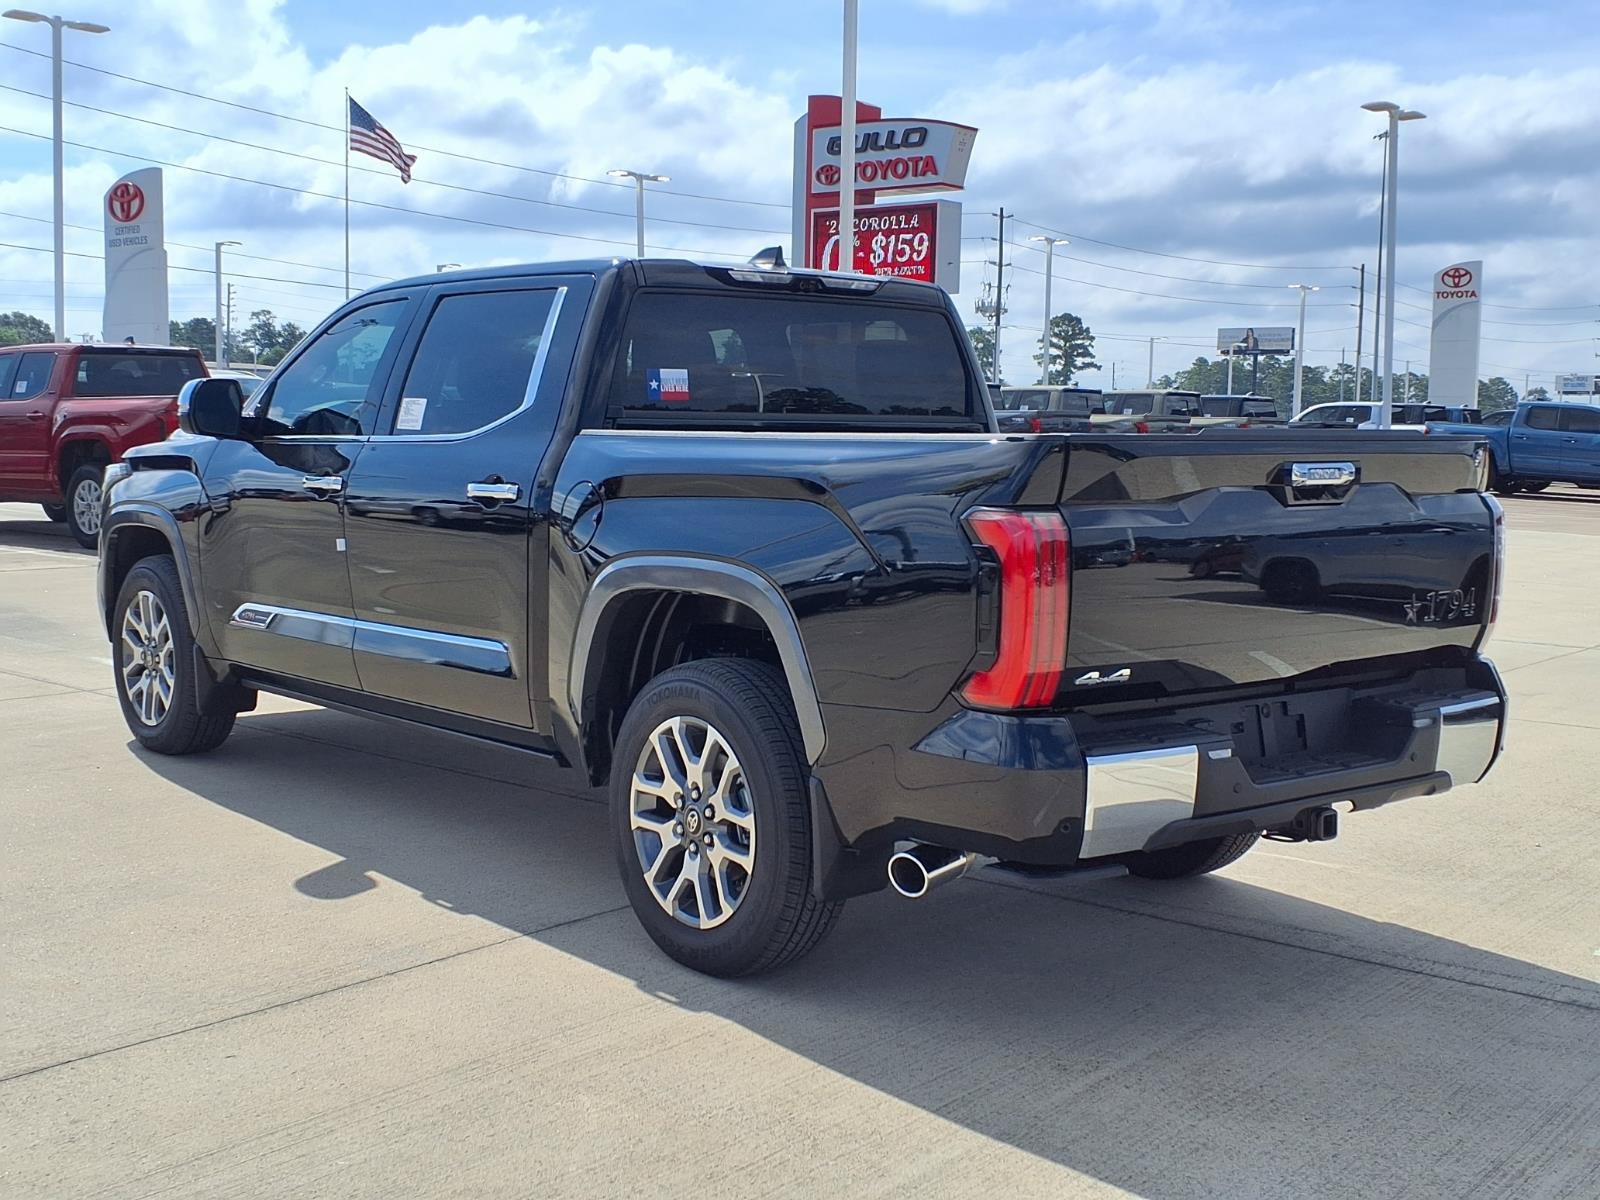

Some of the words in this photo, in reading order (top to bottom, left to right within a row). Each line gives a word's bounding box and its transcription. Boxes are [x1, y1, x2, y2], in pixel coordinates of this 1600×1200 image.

[827, 127, 928, 156] GULLO
[870, 232, 929, 267] $159
[1436, 290, 1477, 299] TOYOTA
[1423, 587, 1476, 622] 1794
